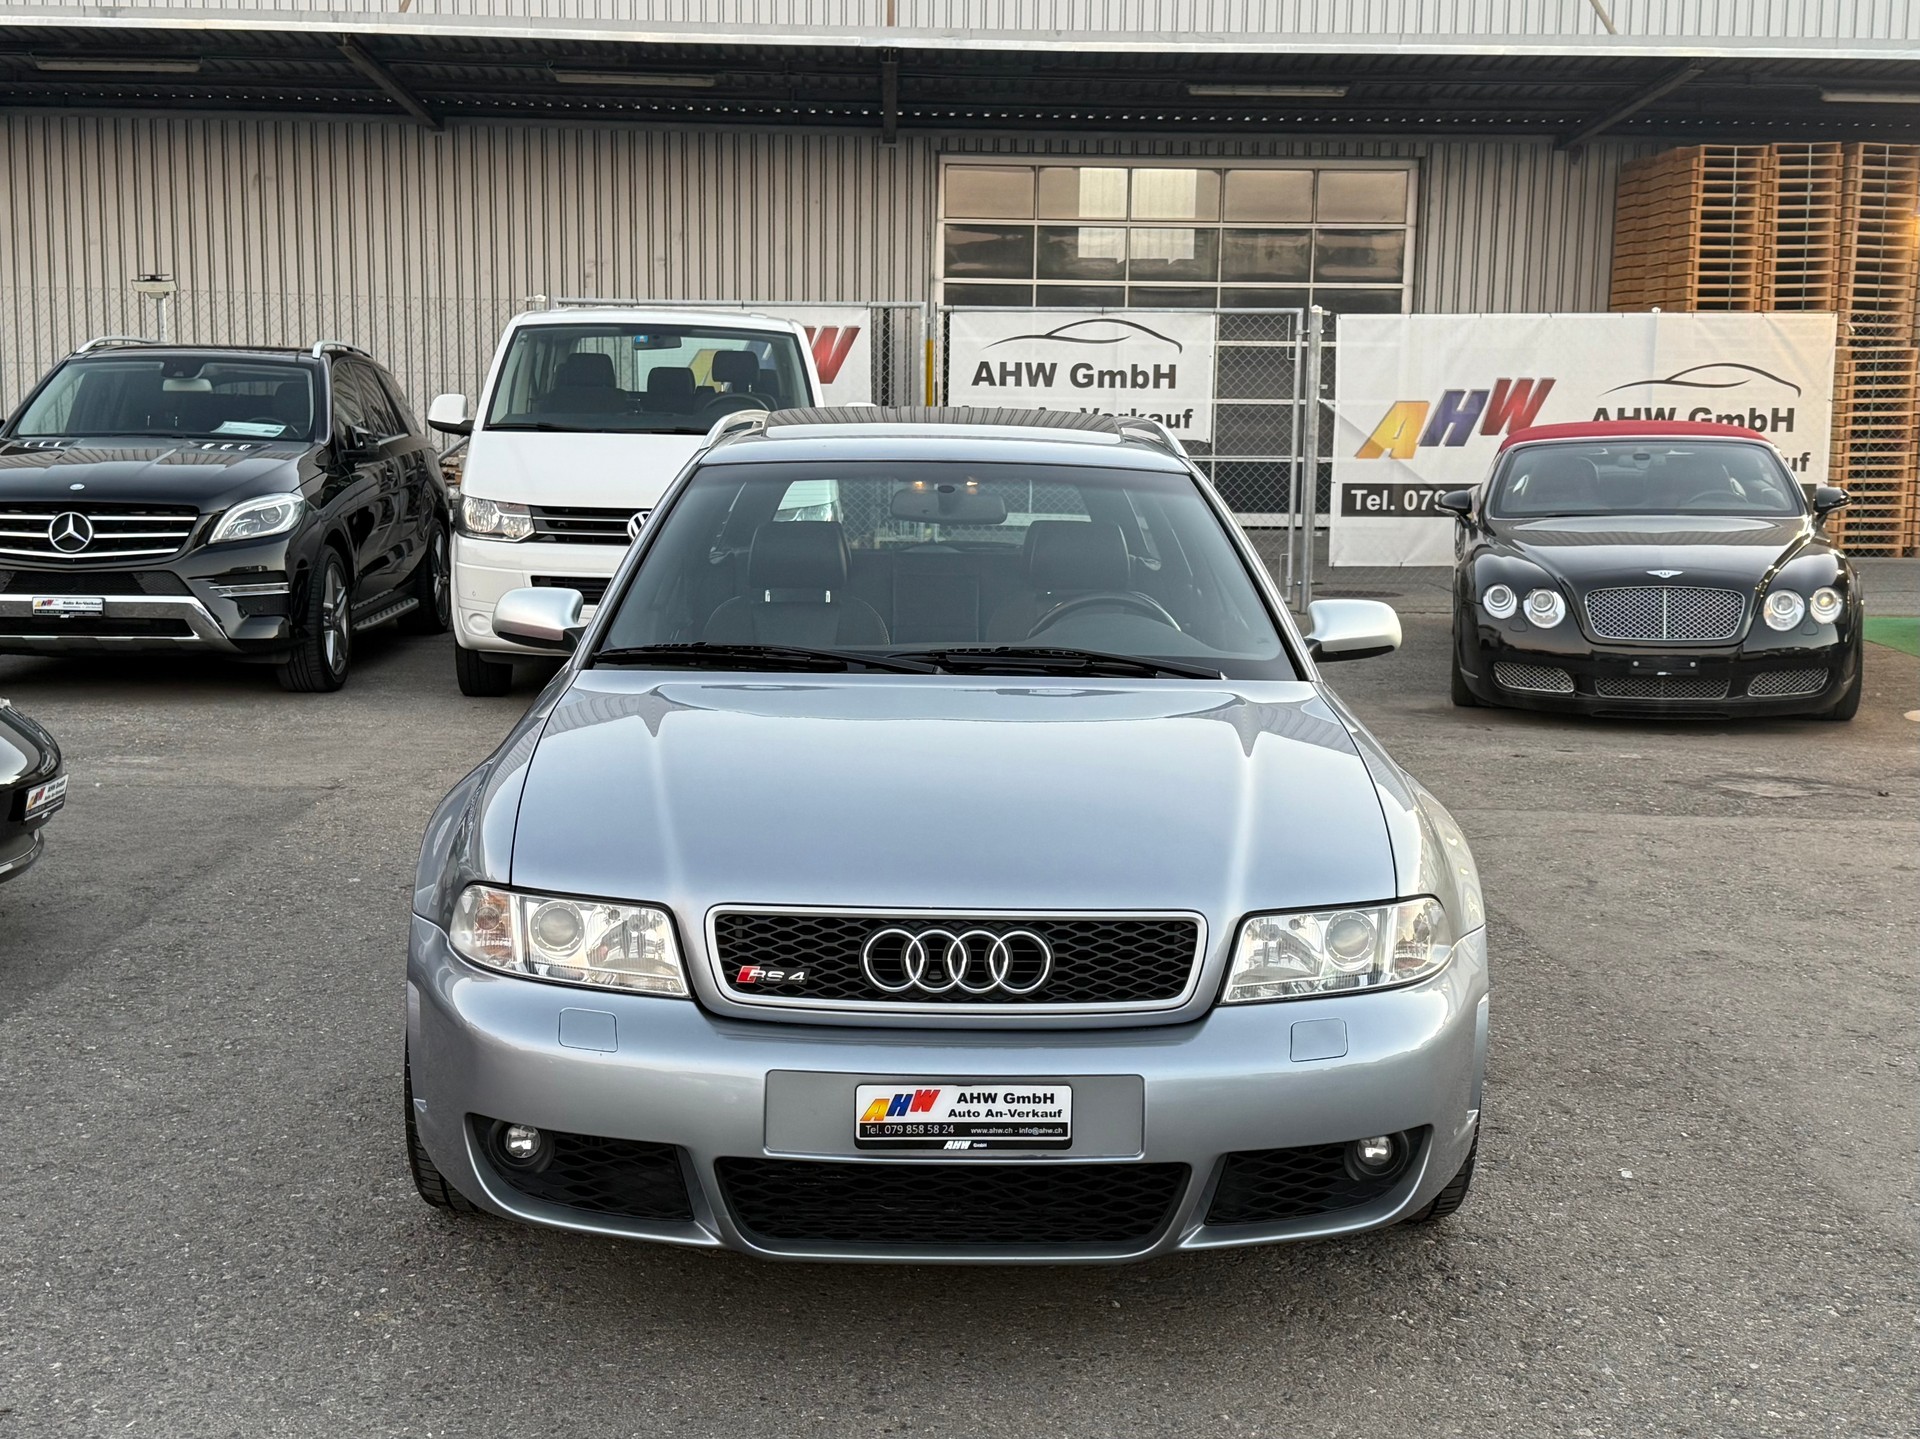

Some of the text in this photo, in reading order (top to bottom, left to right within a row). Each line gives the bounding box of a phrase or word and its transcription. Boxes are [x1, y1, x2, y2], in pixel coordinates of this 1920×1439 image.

[971, 361, 1177, 389] AHW GmbH
[1354, 377, 1557, 460] AHW
[1350, 489, 1396, 511] Tel.
[956, 1092, 1055, 1104] AHW GmbH
[860, 1089, 941, 1121] AHW
[948, 1108, 1063, 1118] Auto An-Verkauf
[865, 1125, 955, 1134] Tel. 079 858 58 24
[1018, 1127, 1063, 1135] info@ahw.ch
[943, 1140, 971, 1150] AHW
